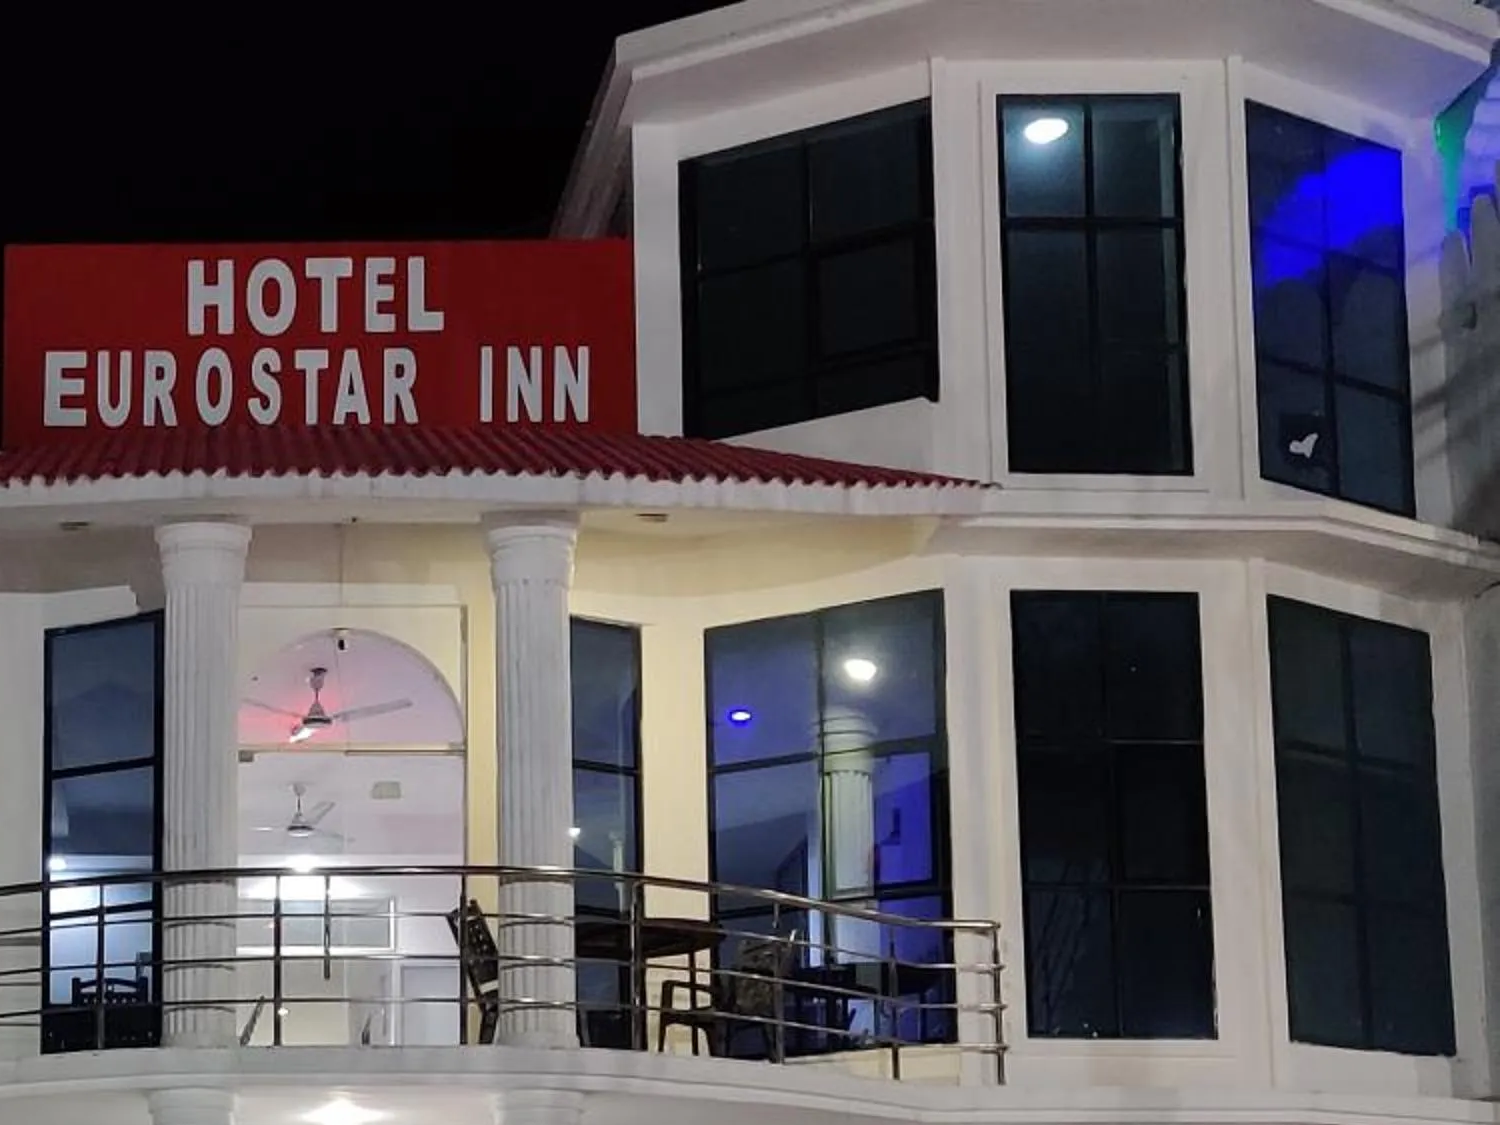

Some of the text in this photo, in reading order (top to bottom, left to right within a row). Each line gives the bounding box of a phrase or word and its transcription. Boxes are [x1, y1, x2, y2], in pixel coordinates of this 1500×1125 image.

[187, 256, 445, 336] HOTEL
[43, 345, 590, 427] EUROSTAR INN
